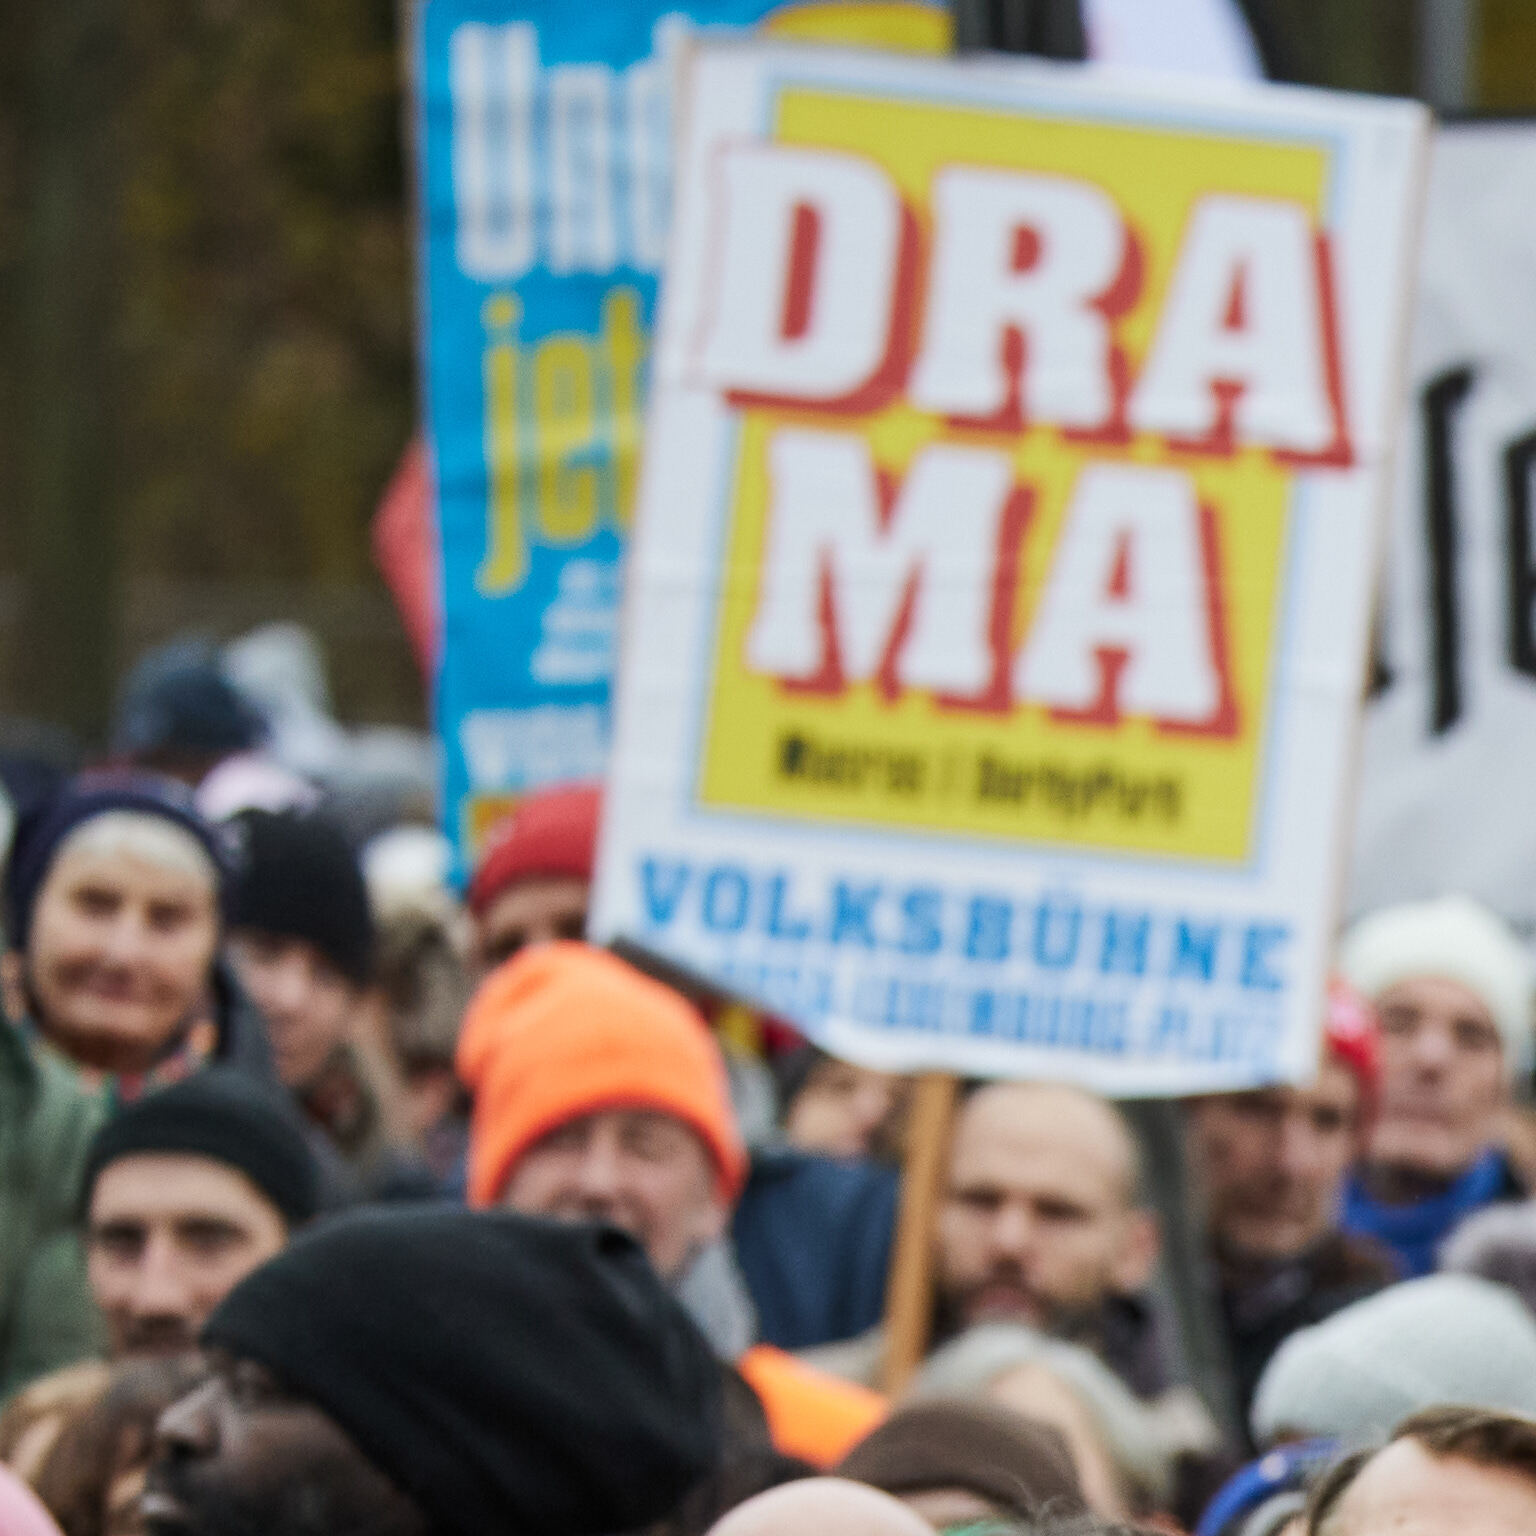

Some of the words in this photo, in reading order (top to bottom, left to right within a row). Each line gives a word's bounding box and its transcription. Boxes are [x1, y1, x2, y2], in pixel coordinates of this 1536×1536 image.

[690, 138, 1356, 470] DRA
[743, 428, 1242, 741] MA
[640, 855, 1290, 993] VOLKSBÜHNE
